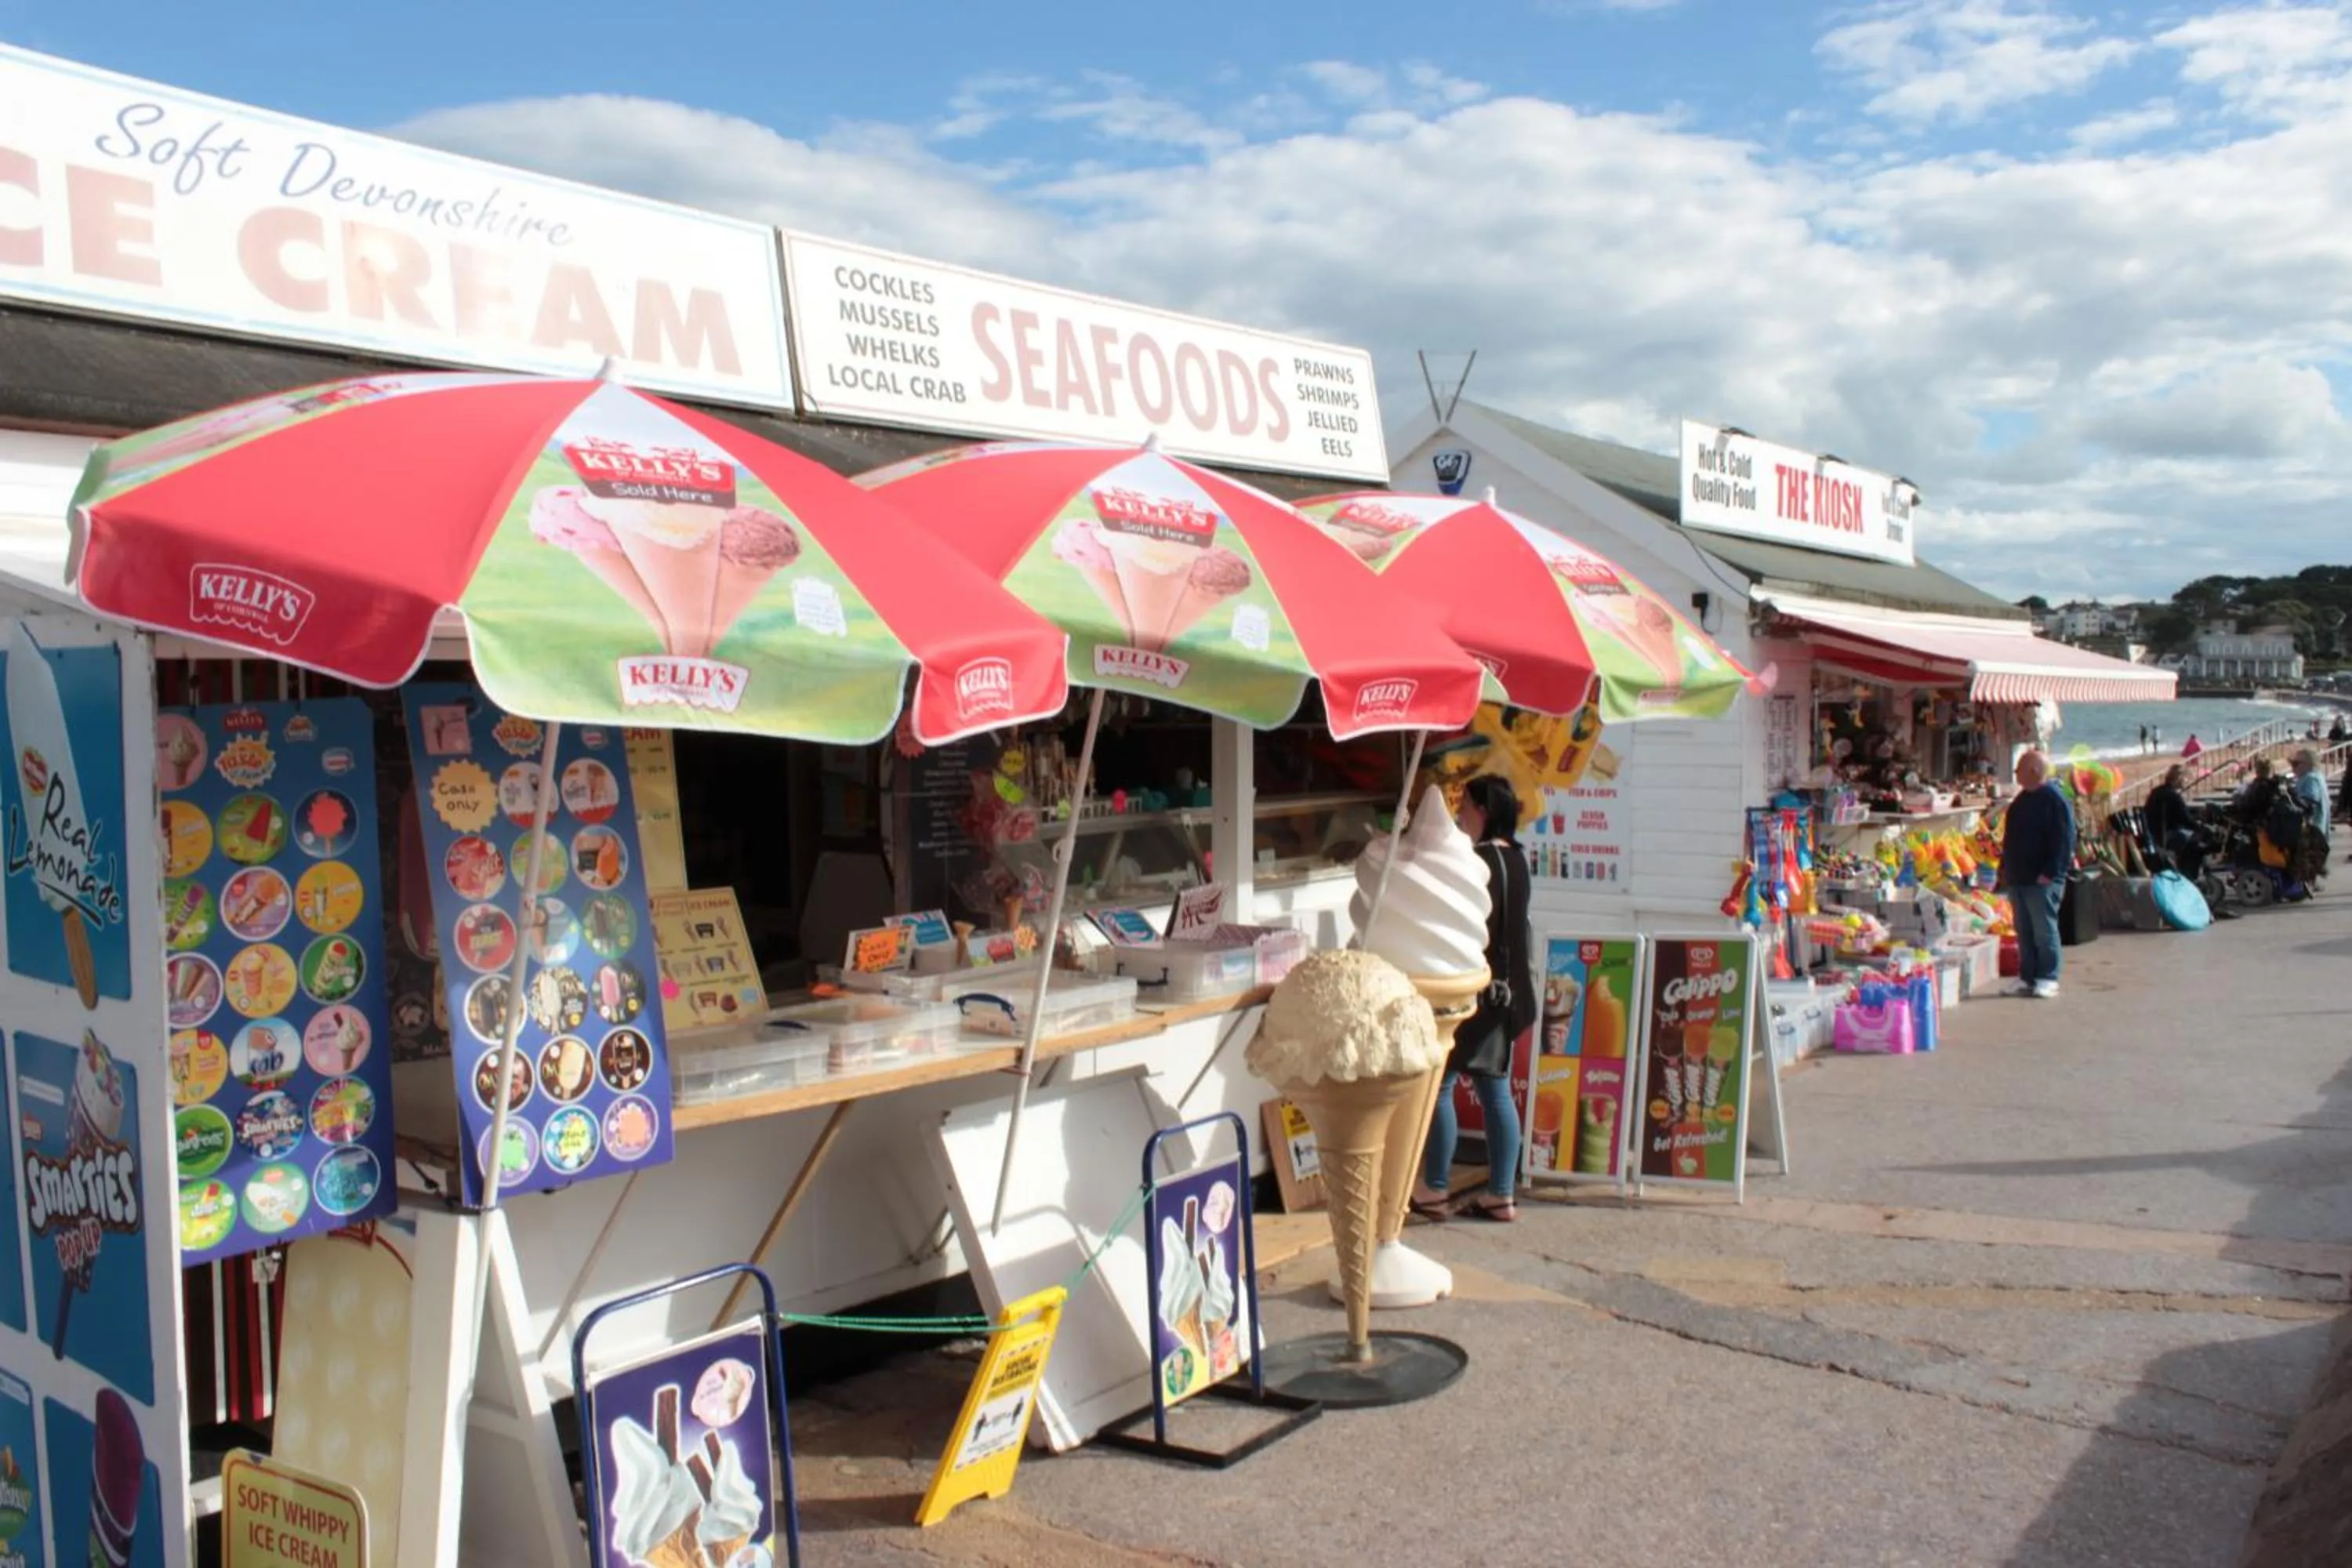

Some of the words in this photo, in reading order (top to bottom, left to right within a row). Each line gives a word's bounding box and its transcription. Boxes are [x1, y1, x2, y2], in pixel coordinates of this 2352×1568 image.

[95, 103, 250, 196] Soft
[278, 143, 574, 246] Devonshire
[238, 206, 742, 377] CREAM
[834, 265, 935, 305] COCKLES
[839, 298, 940, 338] MUSSELS
[846, 332, 941, 369] WHELKS
[828, 363, 904, 395] LOCAL
[909, 376, 967, 404] CRAB
[971, 301, 1290, 444] SEAFOODS
[1294, 358, 1355, 385] PRAWNS
[1297, 383, 1359, 410] SHRIMPS
[1307, 409, 1358, 434] JELLIED
[577, 450, 723, 482] KELLY'S
[1321, 437, 1353, 458] EELS
[1698, 442, 1718, 473] Hot
[611, 481, 659, 499] Sold
[663, 483, 714, 504] Here
[1693, 472, 1732, 509] Quality
[1733, 481, 1756, 511] Food
[1775, 463, 1809, 523] THE
[1813, 474, 1865, 535] KIOSK
[1103, 496, 1209, 528] KELLY'S
[1120, 519, 1155, 536] Sold
[1158, 524, 1196, 543] Here
[200, 573, 301, 622] KELLY'S
[629, 664, 737, 693] KELLY'S
[41, 772, 102, 862] Real
[446, 799, 481, 812] only
[9, 807, 120, 921] Lemonade
[238, 1483, 279, 1519] SOFT
[282, 1497, 350, 1544] WHIPPY
[249, 1521, 274, 1552] ICE
[278, 1533, 338, 1568] CREAM
